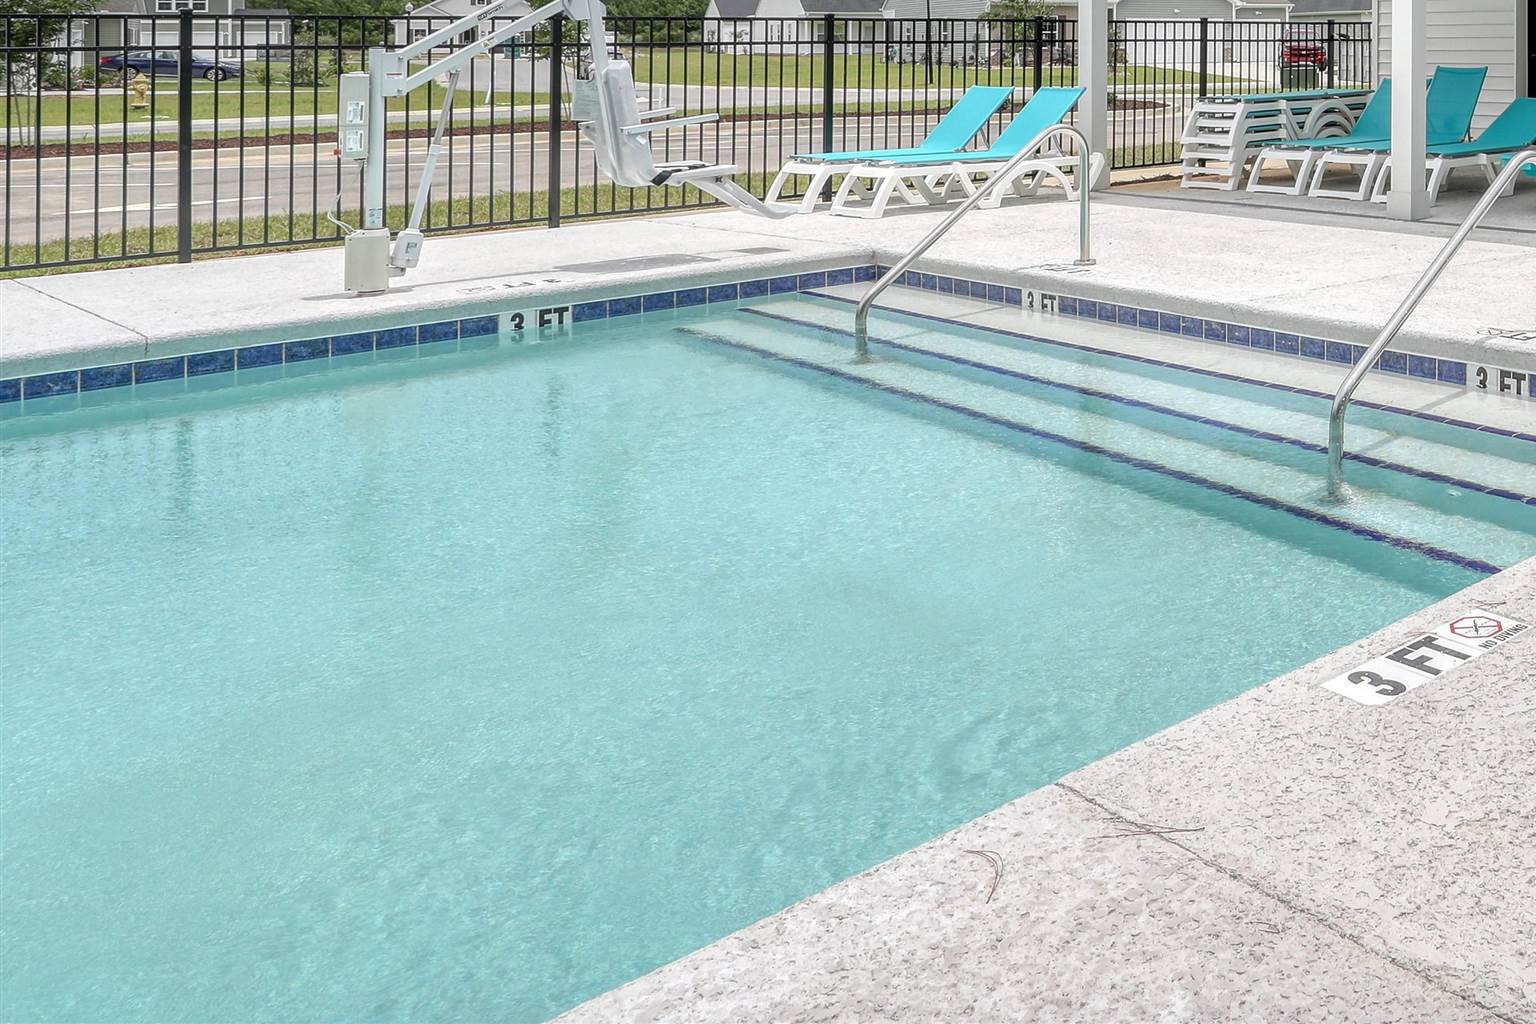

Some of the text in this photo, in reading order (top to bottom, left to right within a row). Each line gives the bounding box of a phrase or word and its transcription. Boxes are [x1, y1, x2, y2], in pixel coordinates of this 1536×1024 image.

[1040, 292, 1057, 312] FT
[538, 306, 570, 328] FT
[1499, 369, 1527, 395] FT
[1478, 623, 1529, 650] NO DIVING
[1347, 635, 1472, 696] 3 FT
